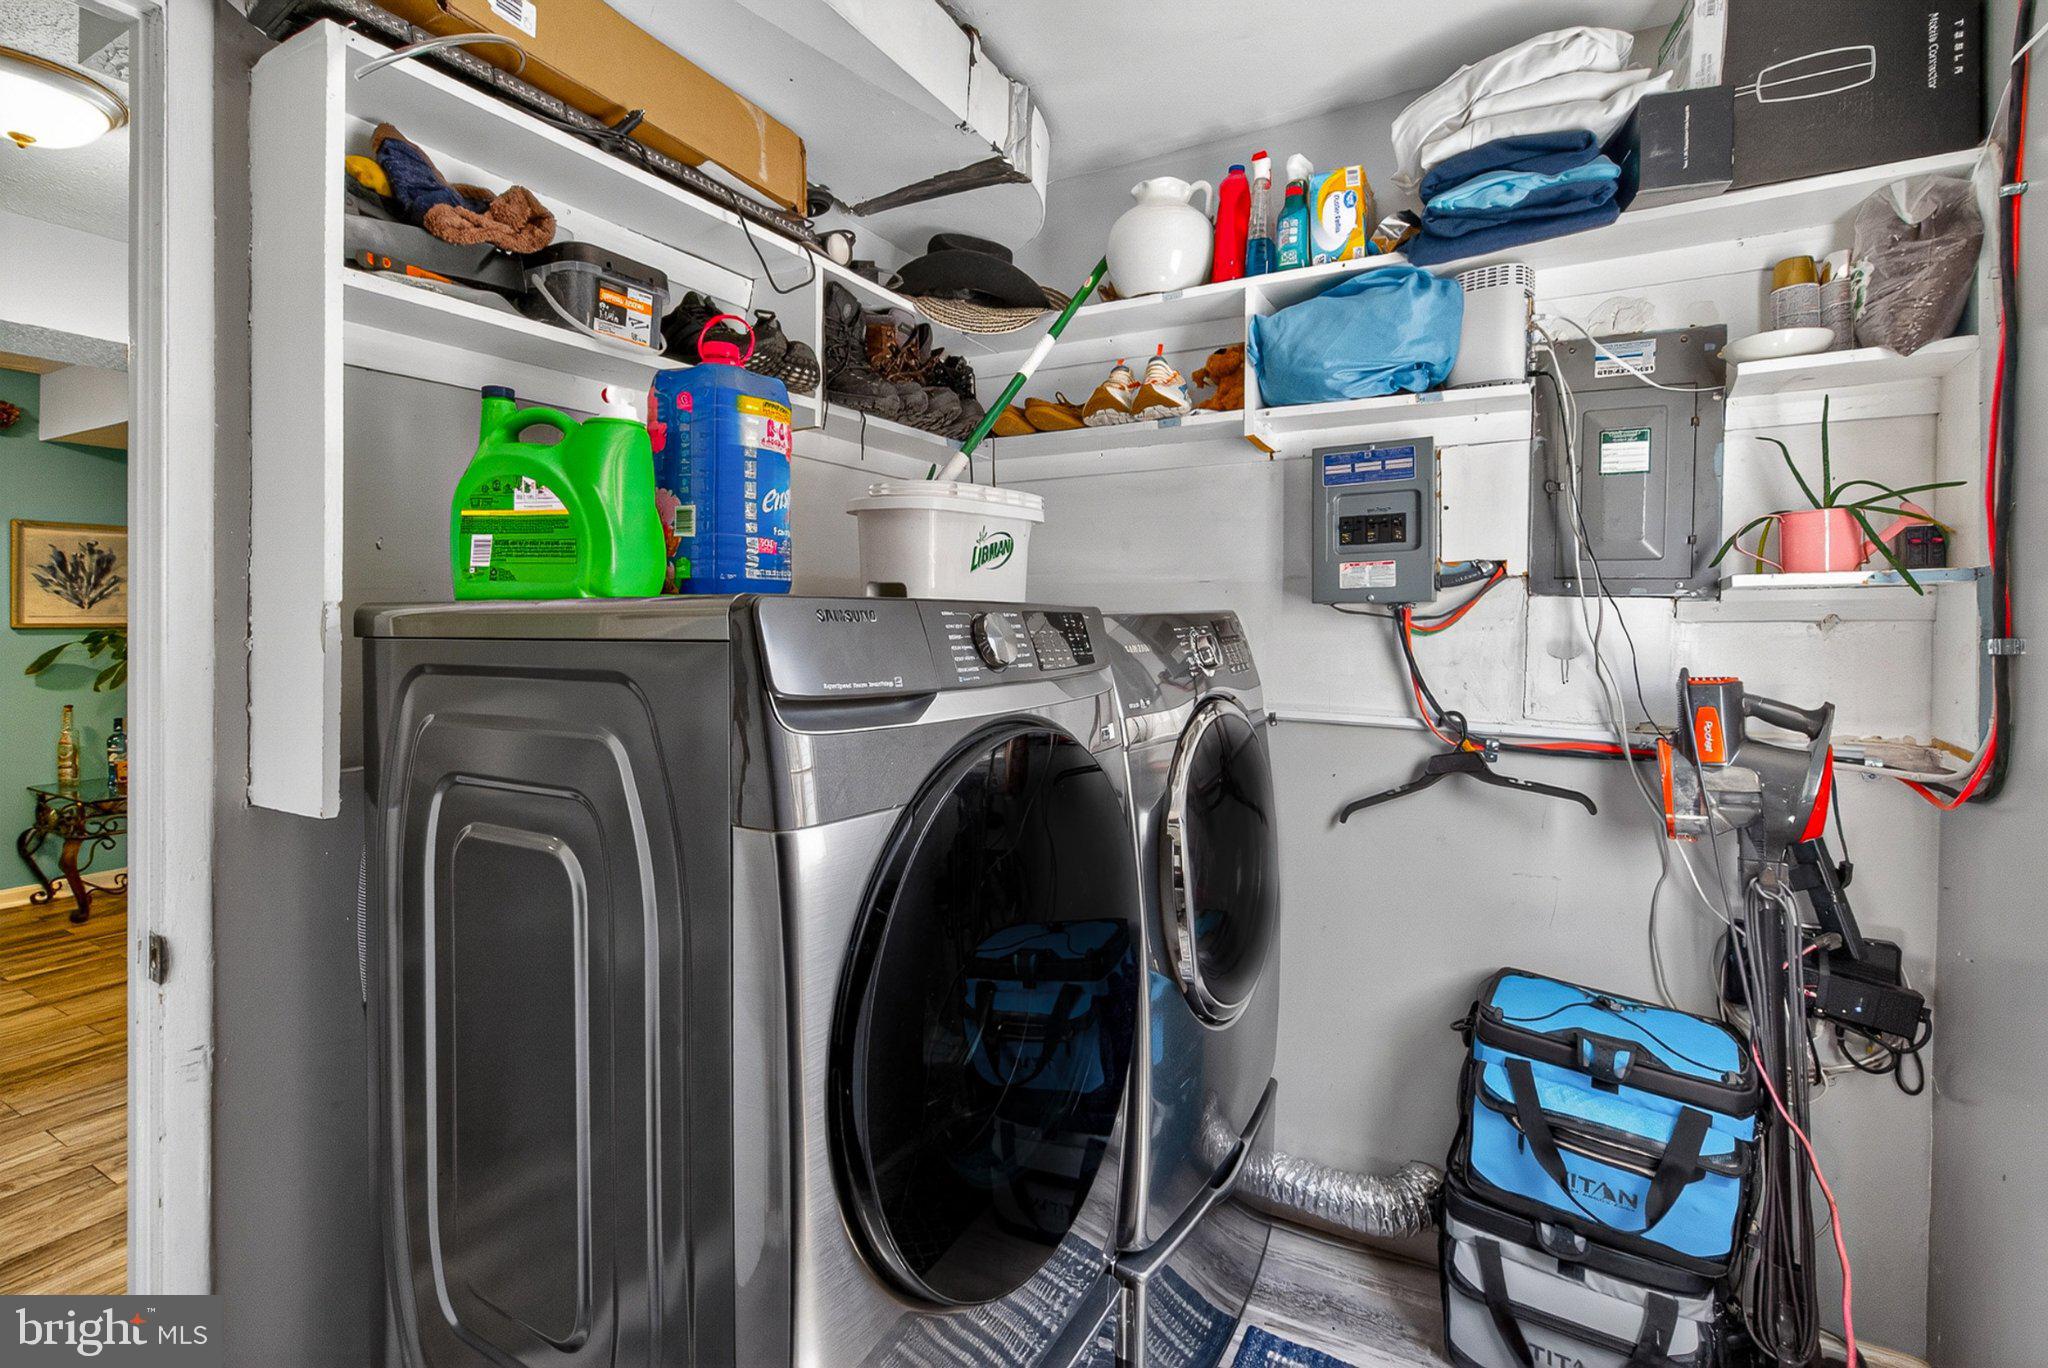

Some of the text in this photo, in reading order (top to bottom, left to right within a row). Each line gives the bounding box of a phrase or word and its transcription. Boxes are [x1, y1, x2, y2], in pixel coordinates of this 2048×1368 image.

[1953, 18, 1965, 75] TESLA
[970, 539, 1011, 573] LIBMAN
[816, 608, 877, 623] SAMSUNG
[1569, 1173, 1639, 1208] ITAN
